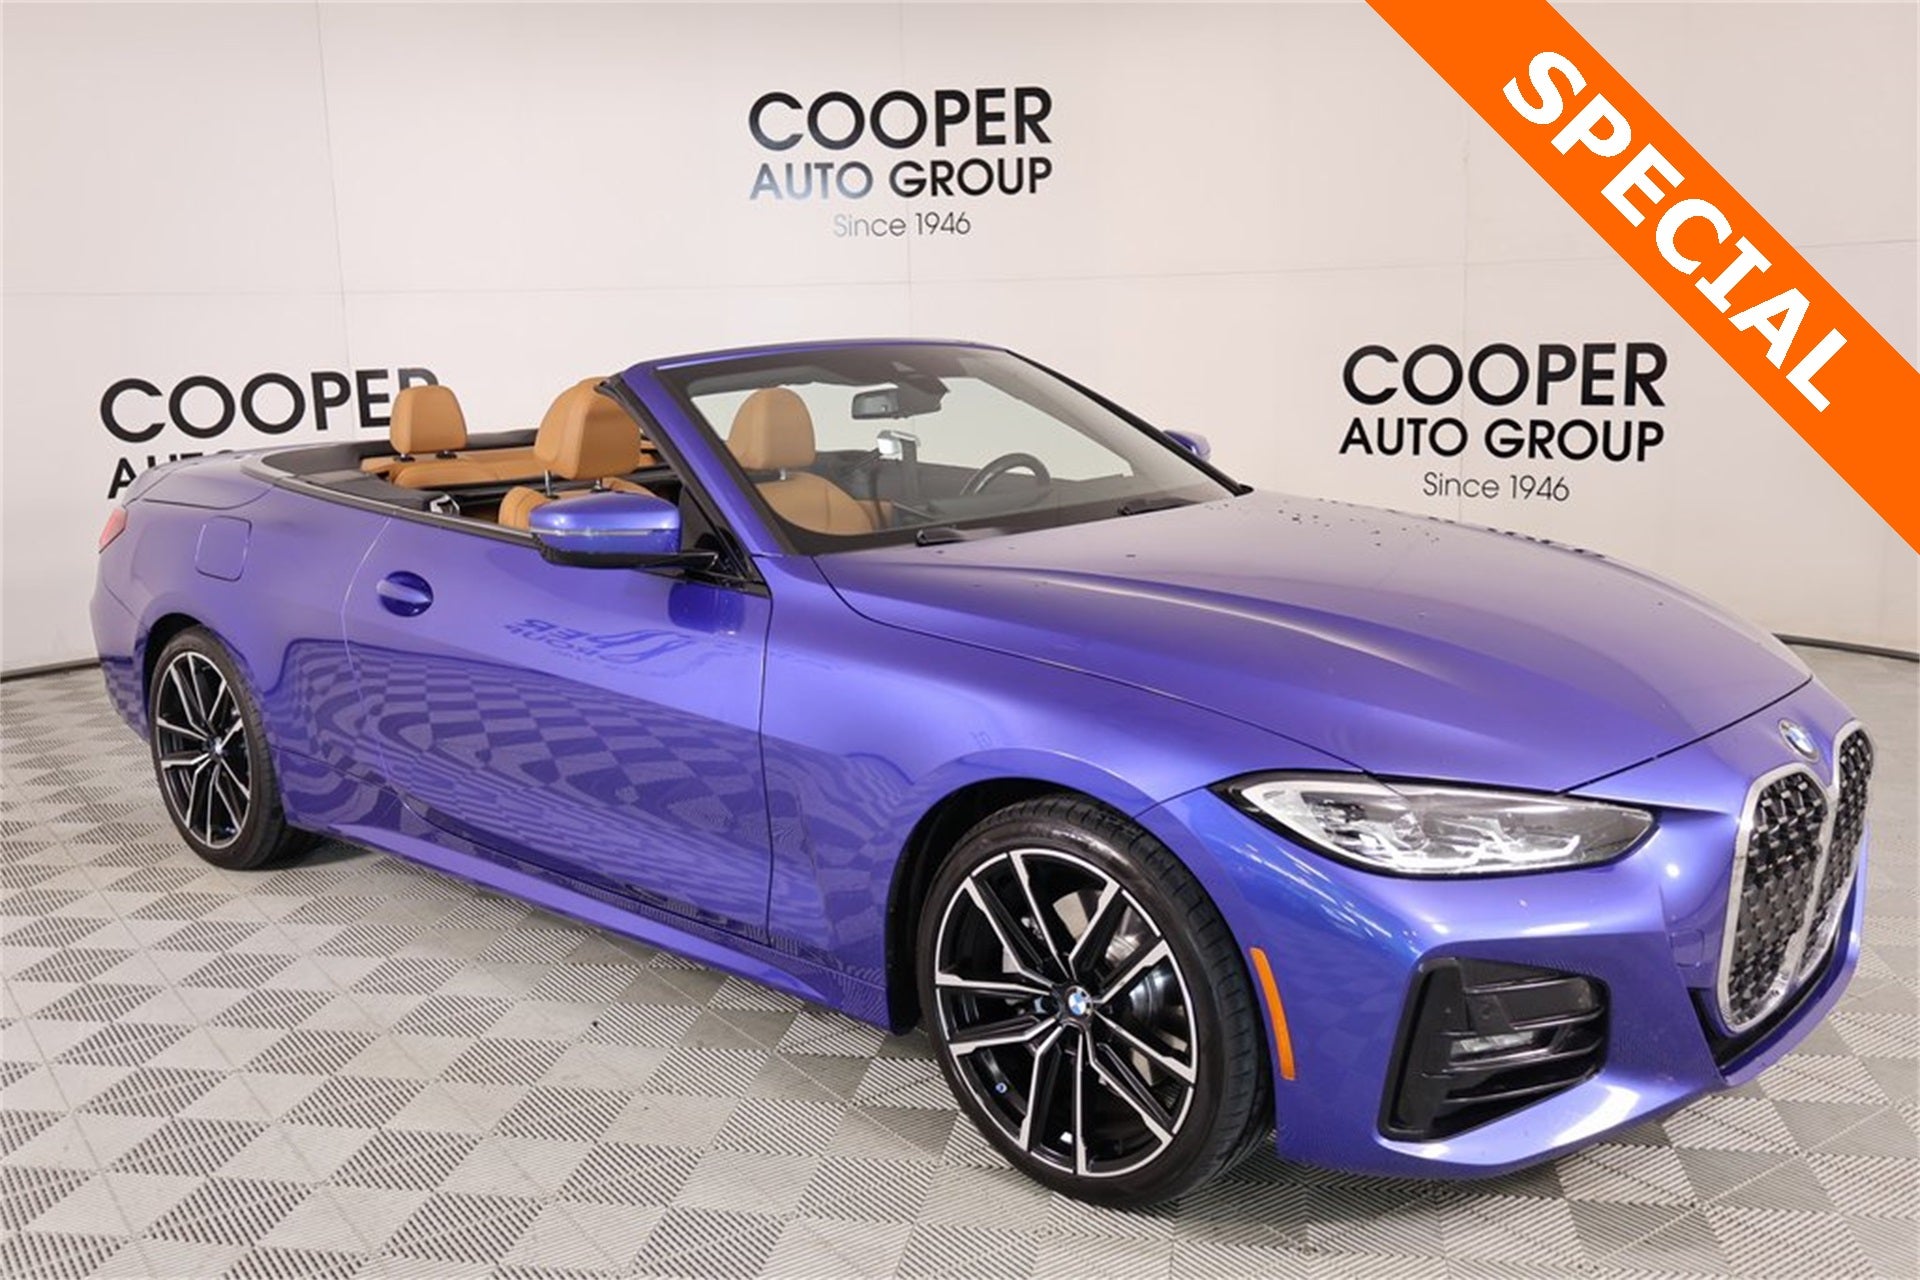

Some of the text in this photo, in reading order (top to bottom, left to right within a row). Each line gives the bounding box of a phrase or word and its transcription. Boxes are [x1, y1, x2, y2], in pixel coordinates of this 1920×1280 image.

[748, 86, 1052, 151] COOPER
[750, 156, 1052, 200] AUTO GROUP
[834, 211, 971, 237] Since 1946
[1343, 342, 1668, 407] COOPER
[1339, 417, 1664, 462] AUTO GROUP
[1423, 472, 1570, 502] Since 1946
